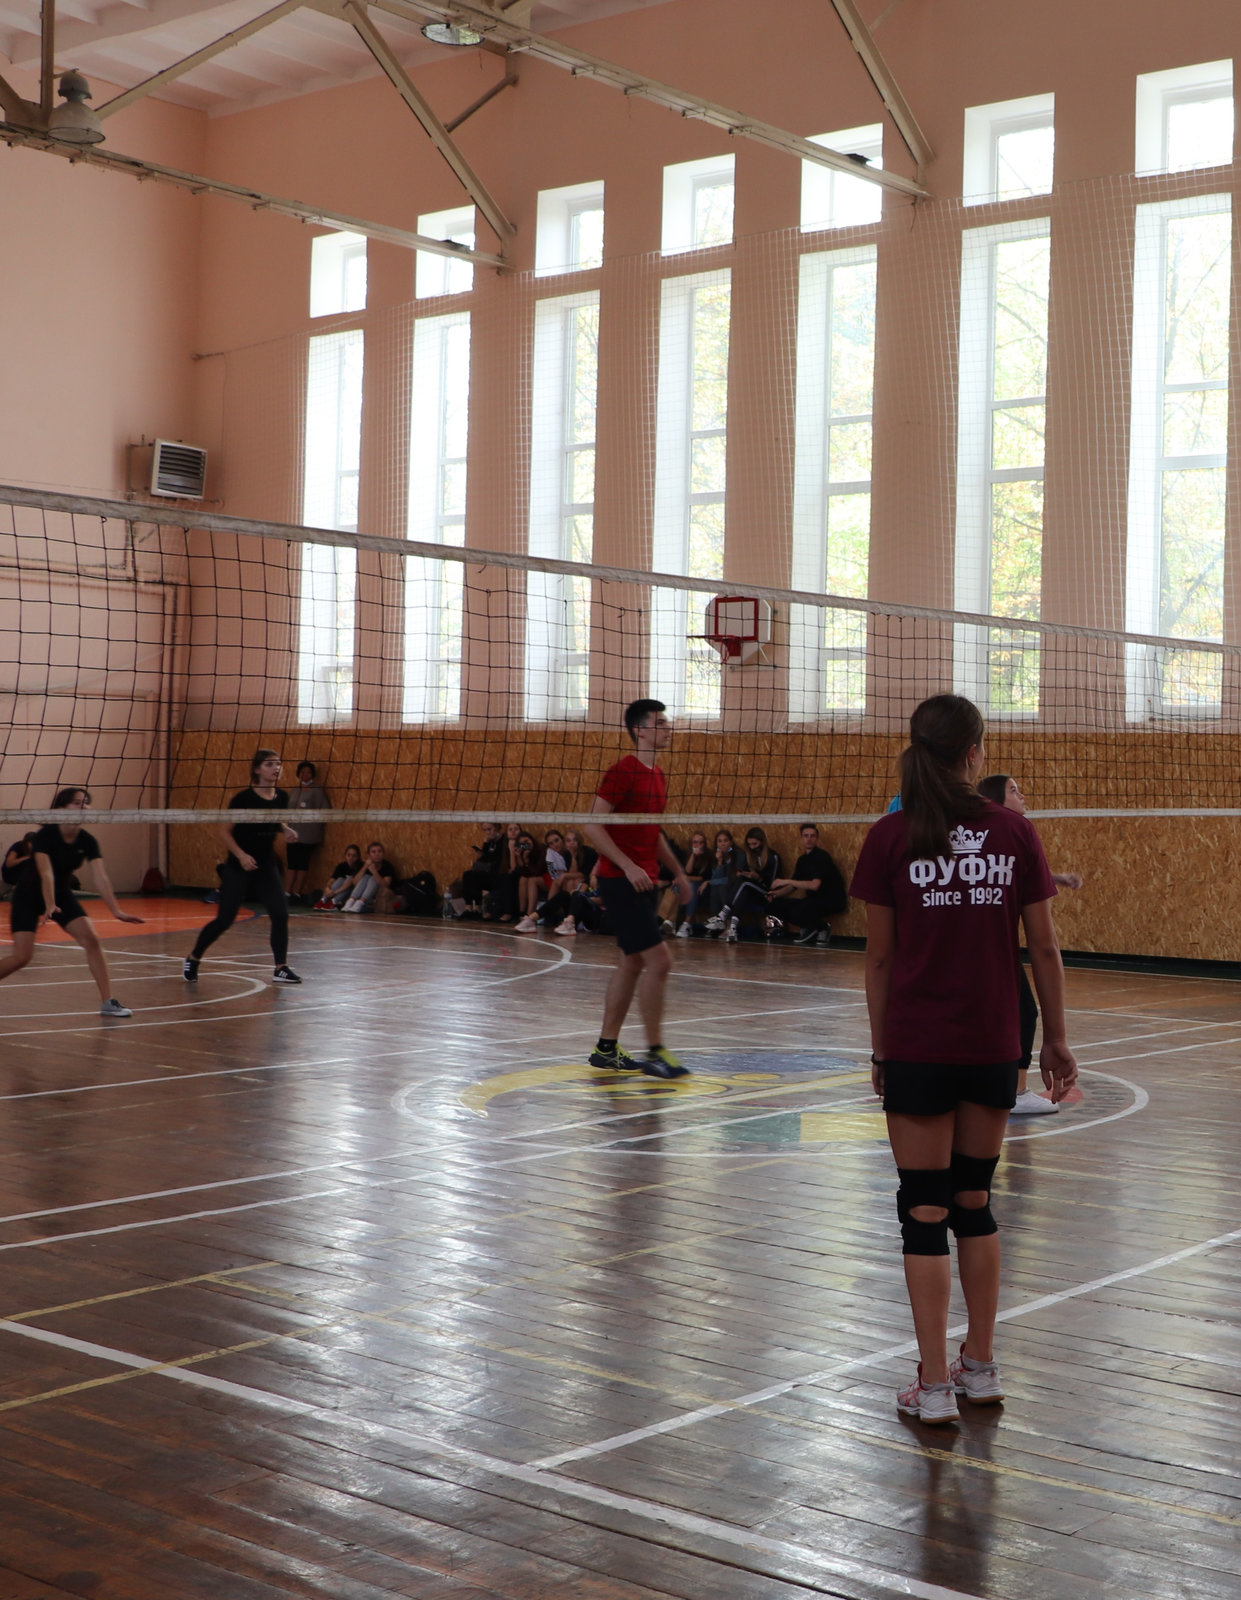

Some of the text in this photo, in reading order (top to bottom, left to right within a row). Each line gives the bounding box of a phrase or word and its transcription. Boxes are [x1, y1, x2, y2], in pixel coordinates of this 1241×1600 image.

[909, 854, 1016, 888] ФУФЖ
[922, 887, 1003, 907] since 1992
